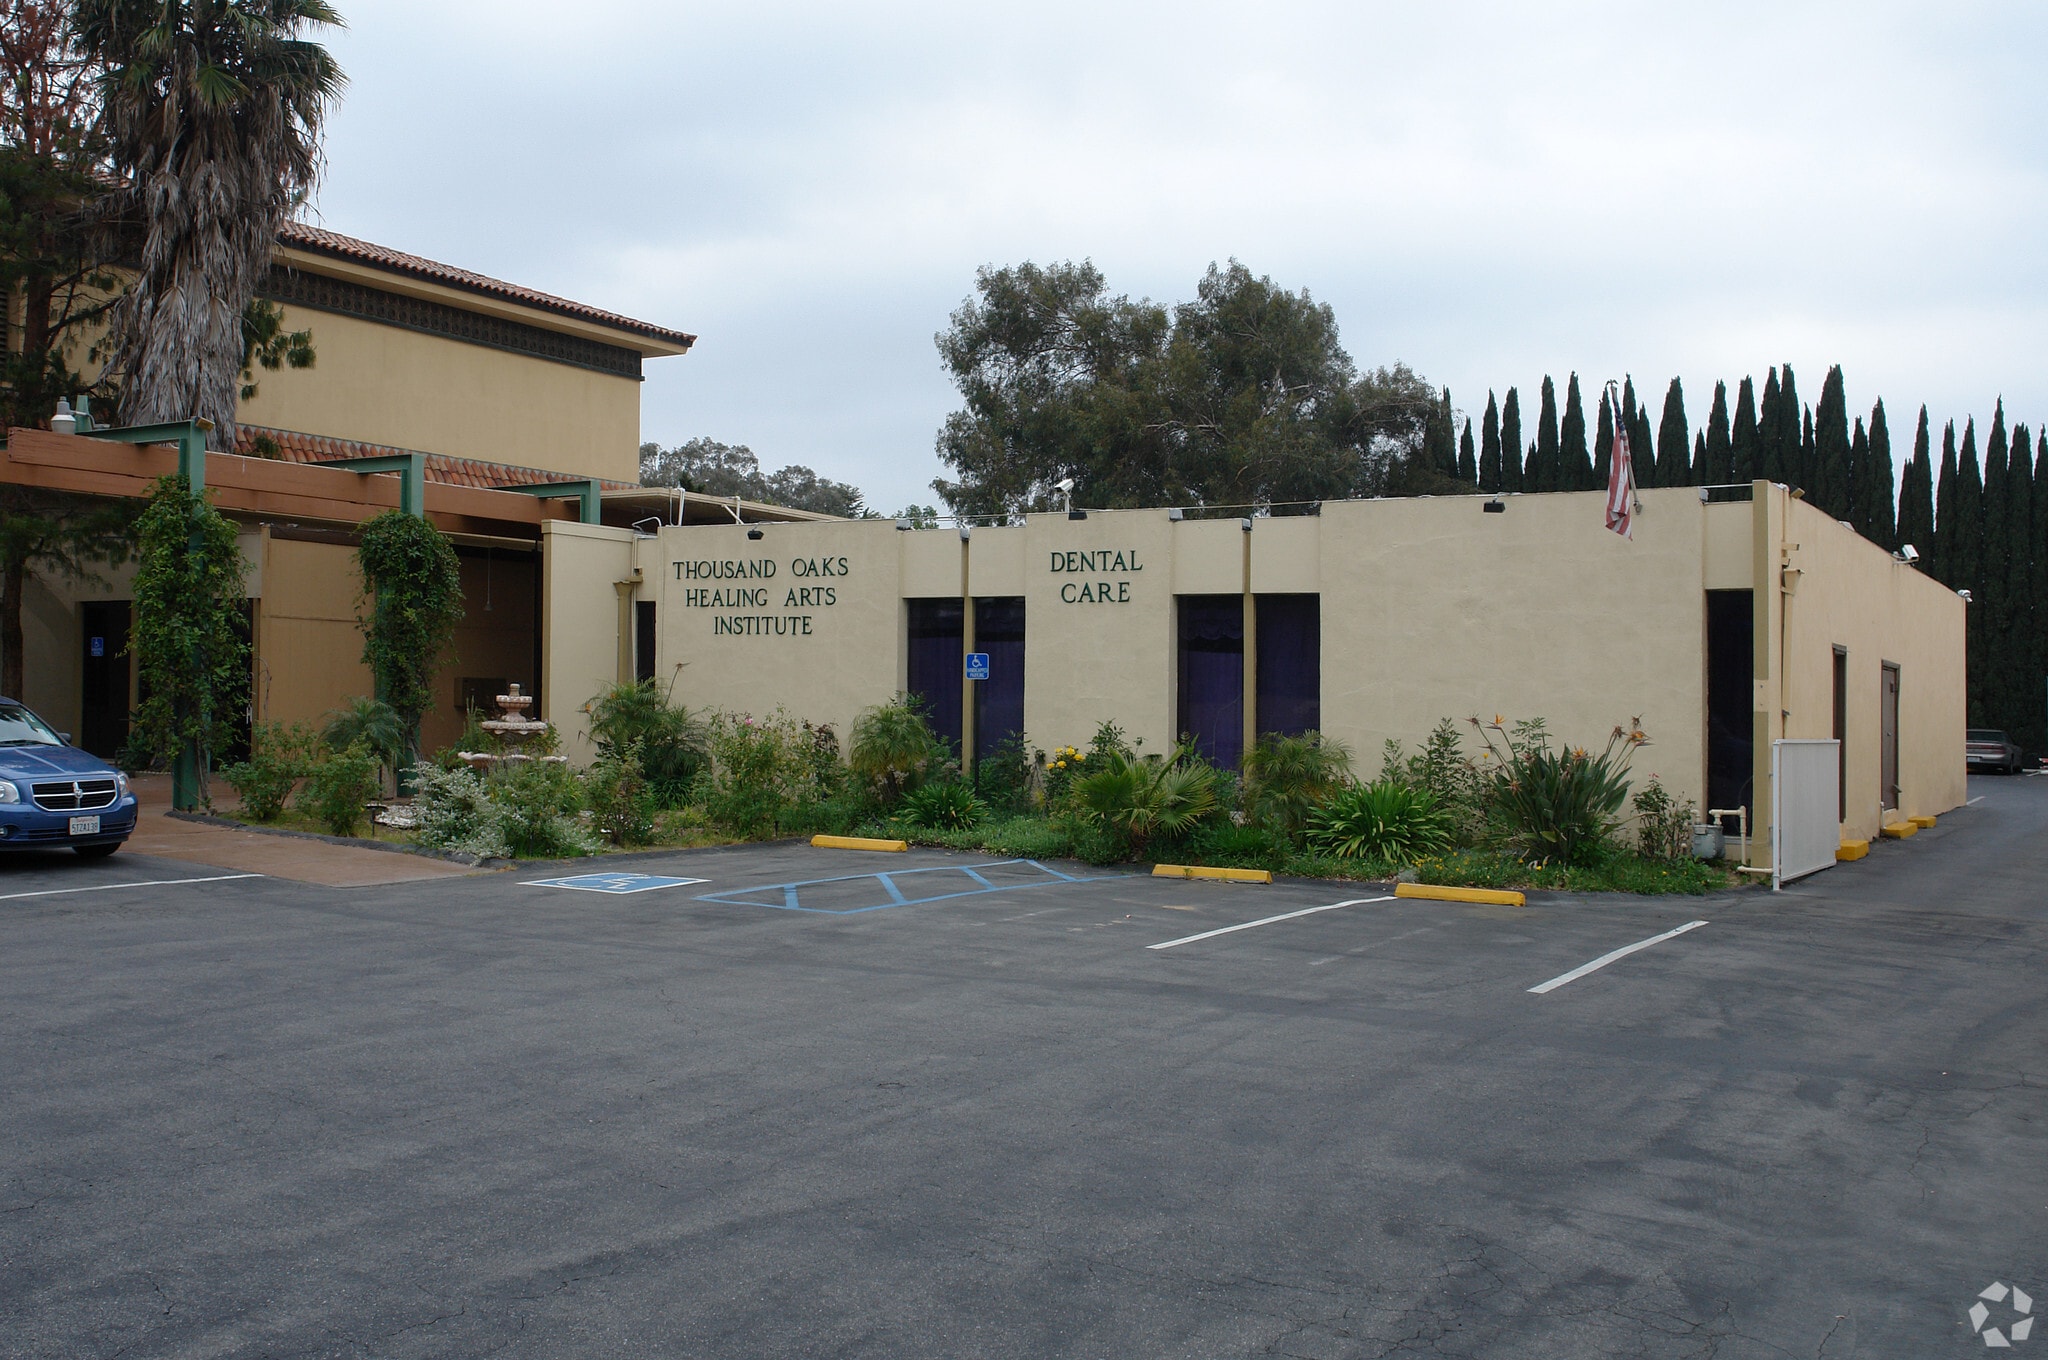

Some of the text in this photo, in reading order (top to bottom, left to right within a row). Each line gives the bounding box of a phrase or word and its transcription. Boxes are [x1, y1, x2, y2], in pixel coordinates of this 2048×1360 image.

[673, 557, 849, 580] THOUSAND OAKS
[1050, 550, 1143, 572] DENTAL
[686, 587, 837, 608] HEALING ARTS
[1061, 582, 1130, 603] CARE
[714, 616, 813, 636] INSTITUTE
